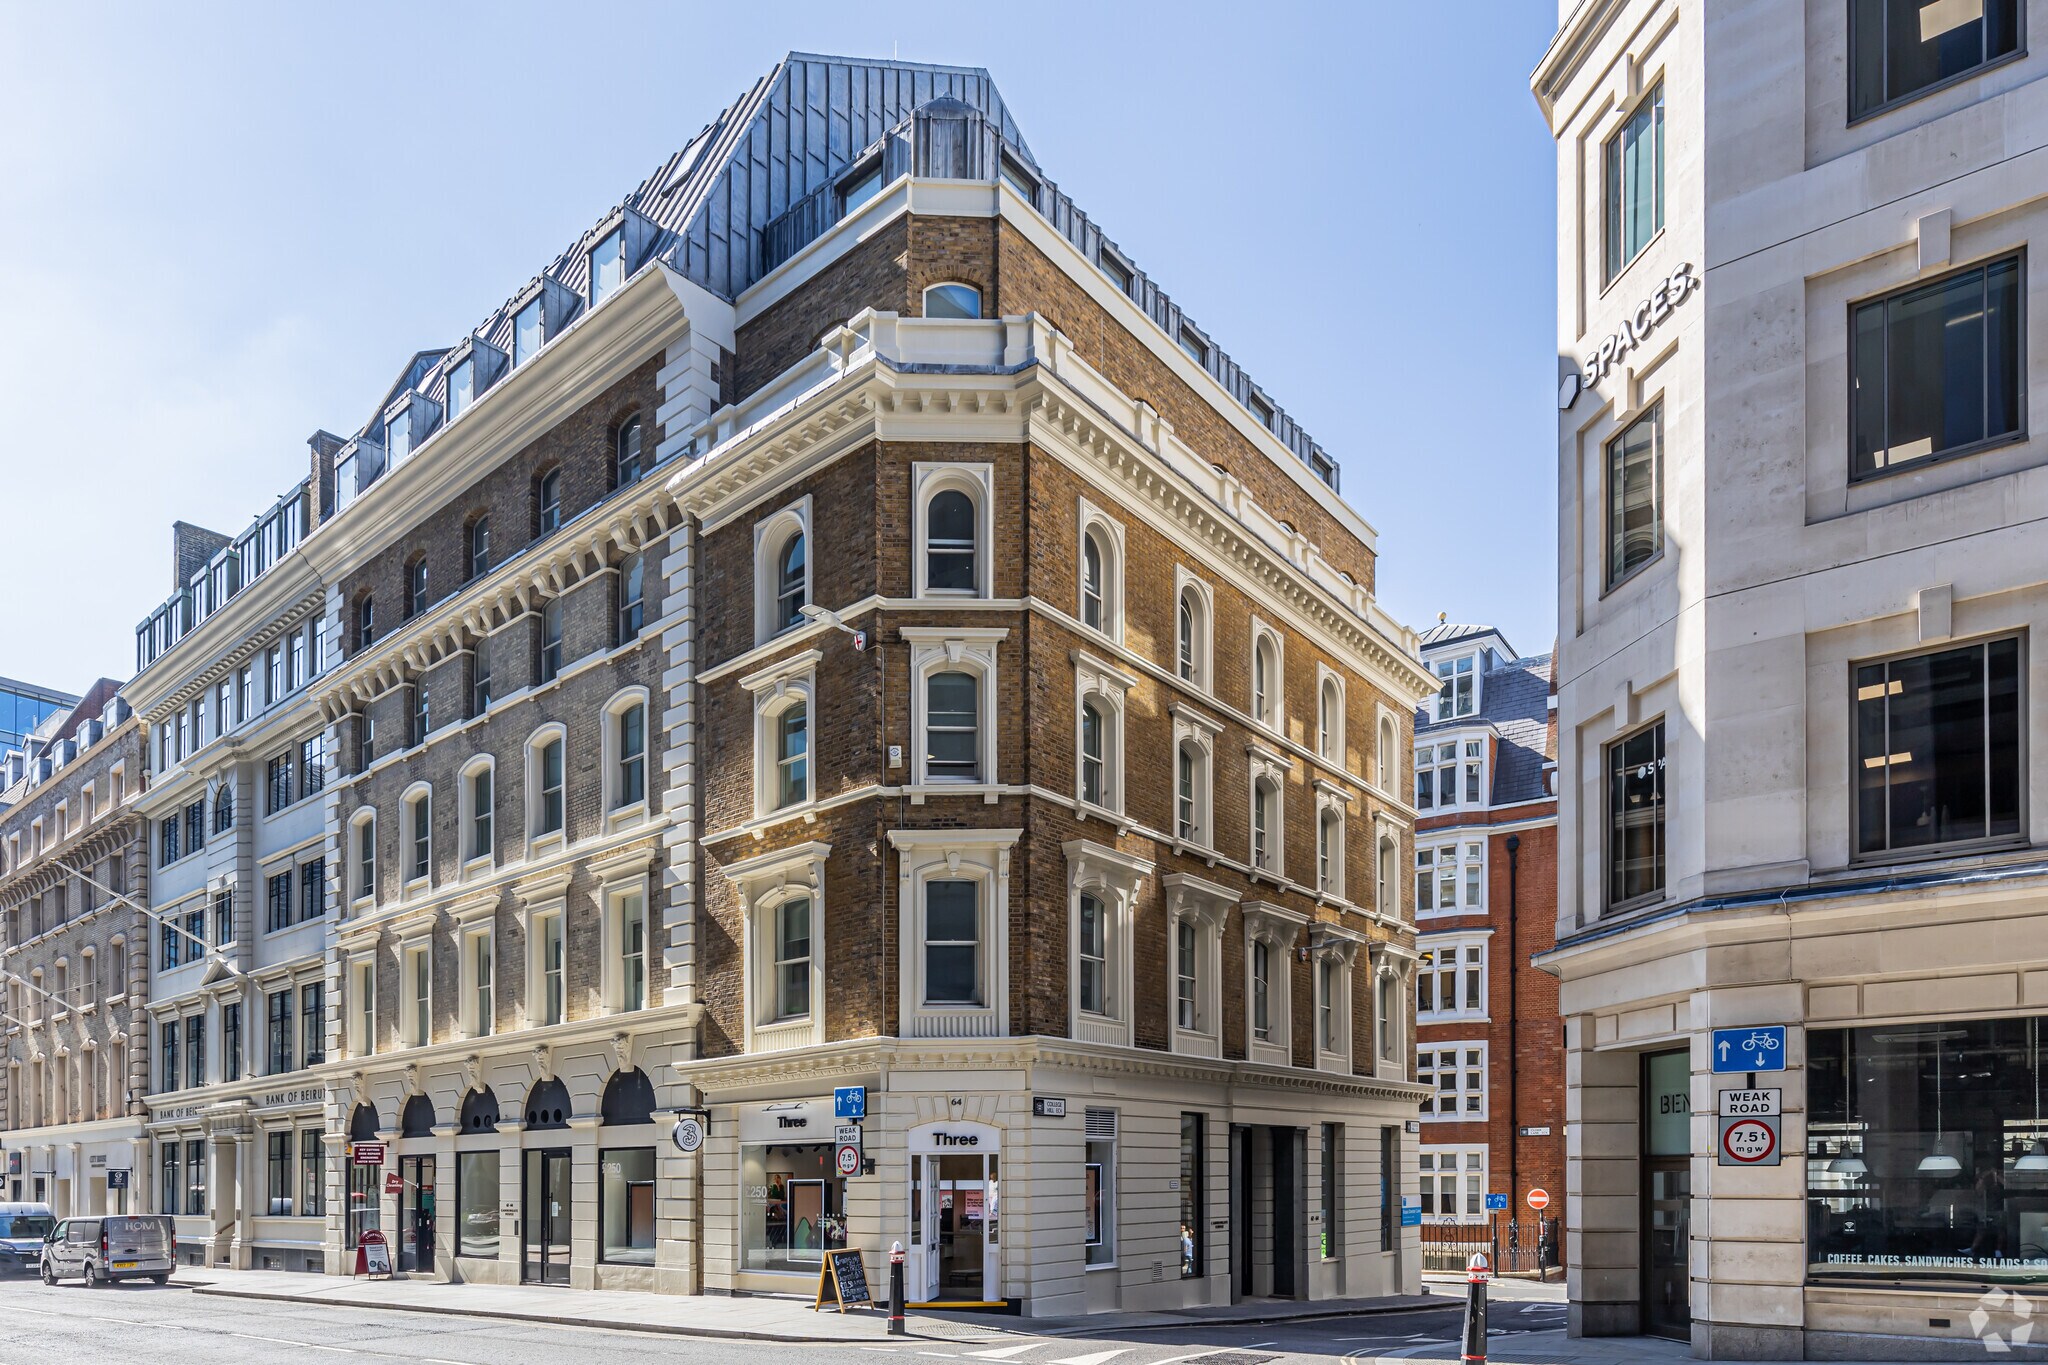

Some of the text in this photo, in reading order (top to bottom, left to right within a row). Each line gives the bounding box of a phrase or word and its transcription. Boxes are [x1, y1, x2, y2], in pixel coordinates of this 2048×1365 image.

[265, 1088, 325, 1105] BANK OF BEIRUT
[951, 1098, 962, 1106] 64
[1729, 1091, 1771, 1102] WEAK
[160, 1108, 174, 1119] BANK
[176, 1107, 185, 1117] OF
[1729, 1103, 1770, 1113] ROAD
[777, 1116, 807, 1129] Three
[839, 1134, 857, 1142] ROAD
[933, 1132, 978, 1146] Three
[1979, 1257, 2020, 1270] SALADS
[2022, 1259, 2030, 1270] &
